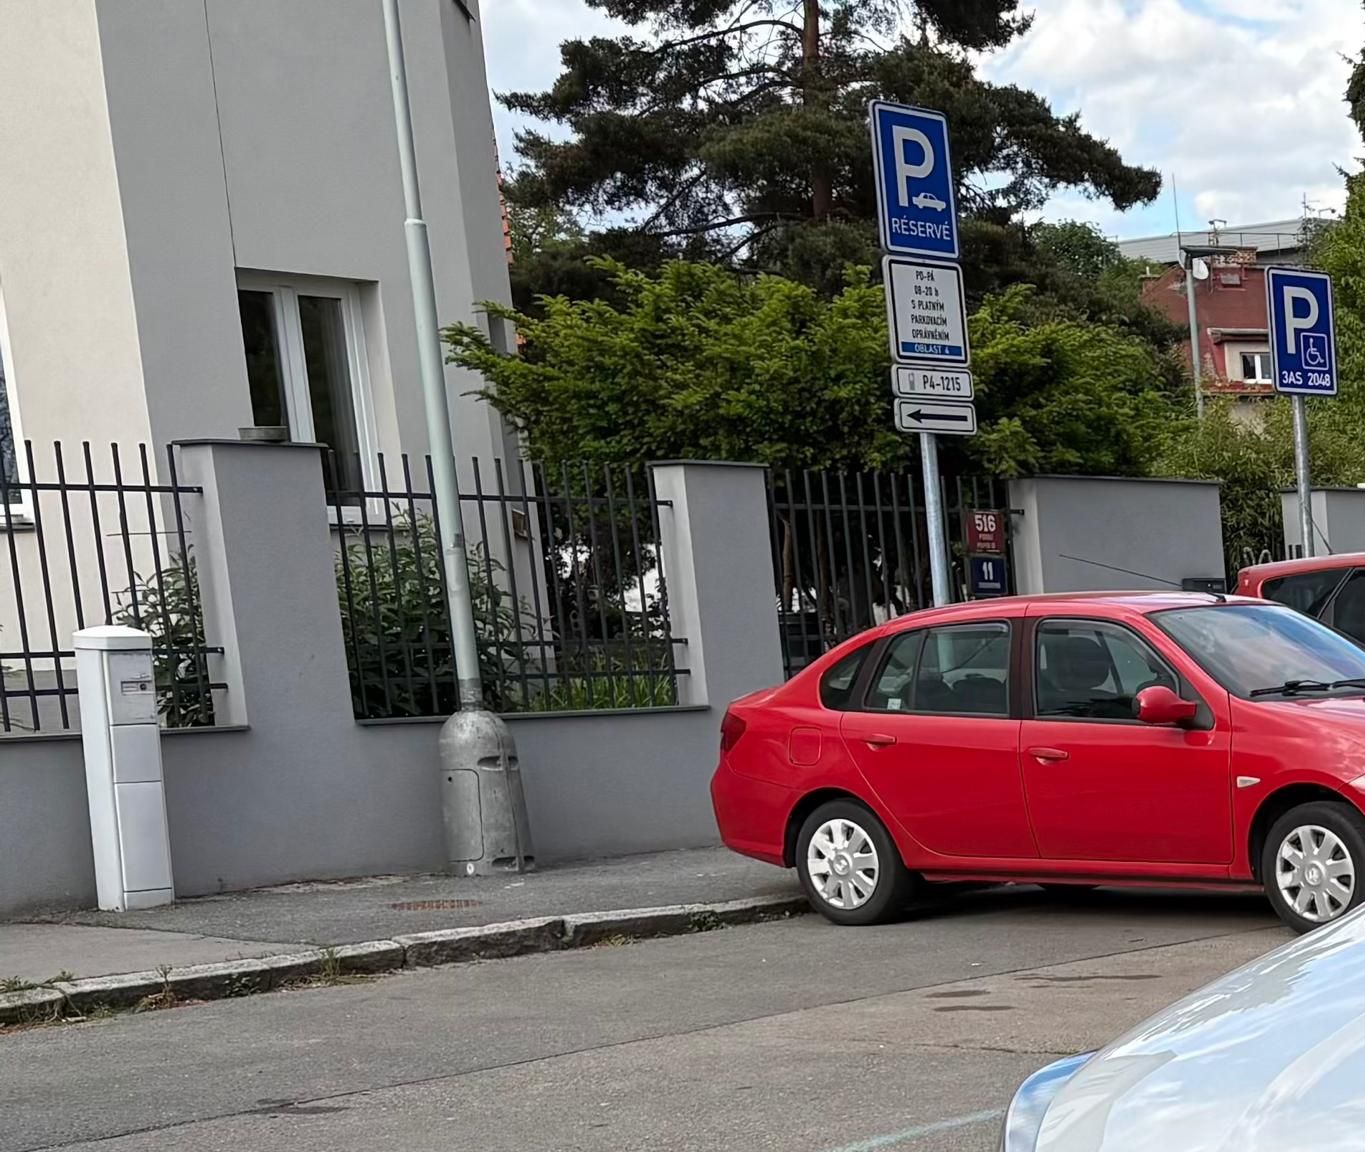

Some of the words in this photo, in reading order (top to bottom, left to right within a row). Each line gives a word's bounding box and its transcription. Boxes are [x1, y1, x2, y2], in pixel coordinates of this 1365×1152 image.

[892, 125, 934, 207] P
[891, 215, 951, 240] RÉSERVÉ
[911, 300, 916, 309] S
[918, 300, 945, 312] PLATNÝM
[911, 314, 948, 326] PARKOVACÍM
[1283, 285, 1319, 354] P
[914, 343, 942, 354] OBLAST
[922, 374, 961, 391] P4-1215
[1281, 371, 1303, 385] 3AS
[1307, 372, 1331, 386] 2048
[975, 514, 996, 532] 516
[982, 561, 993, 580] 11
